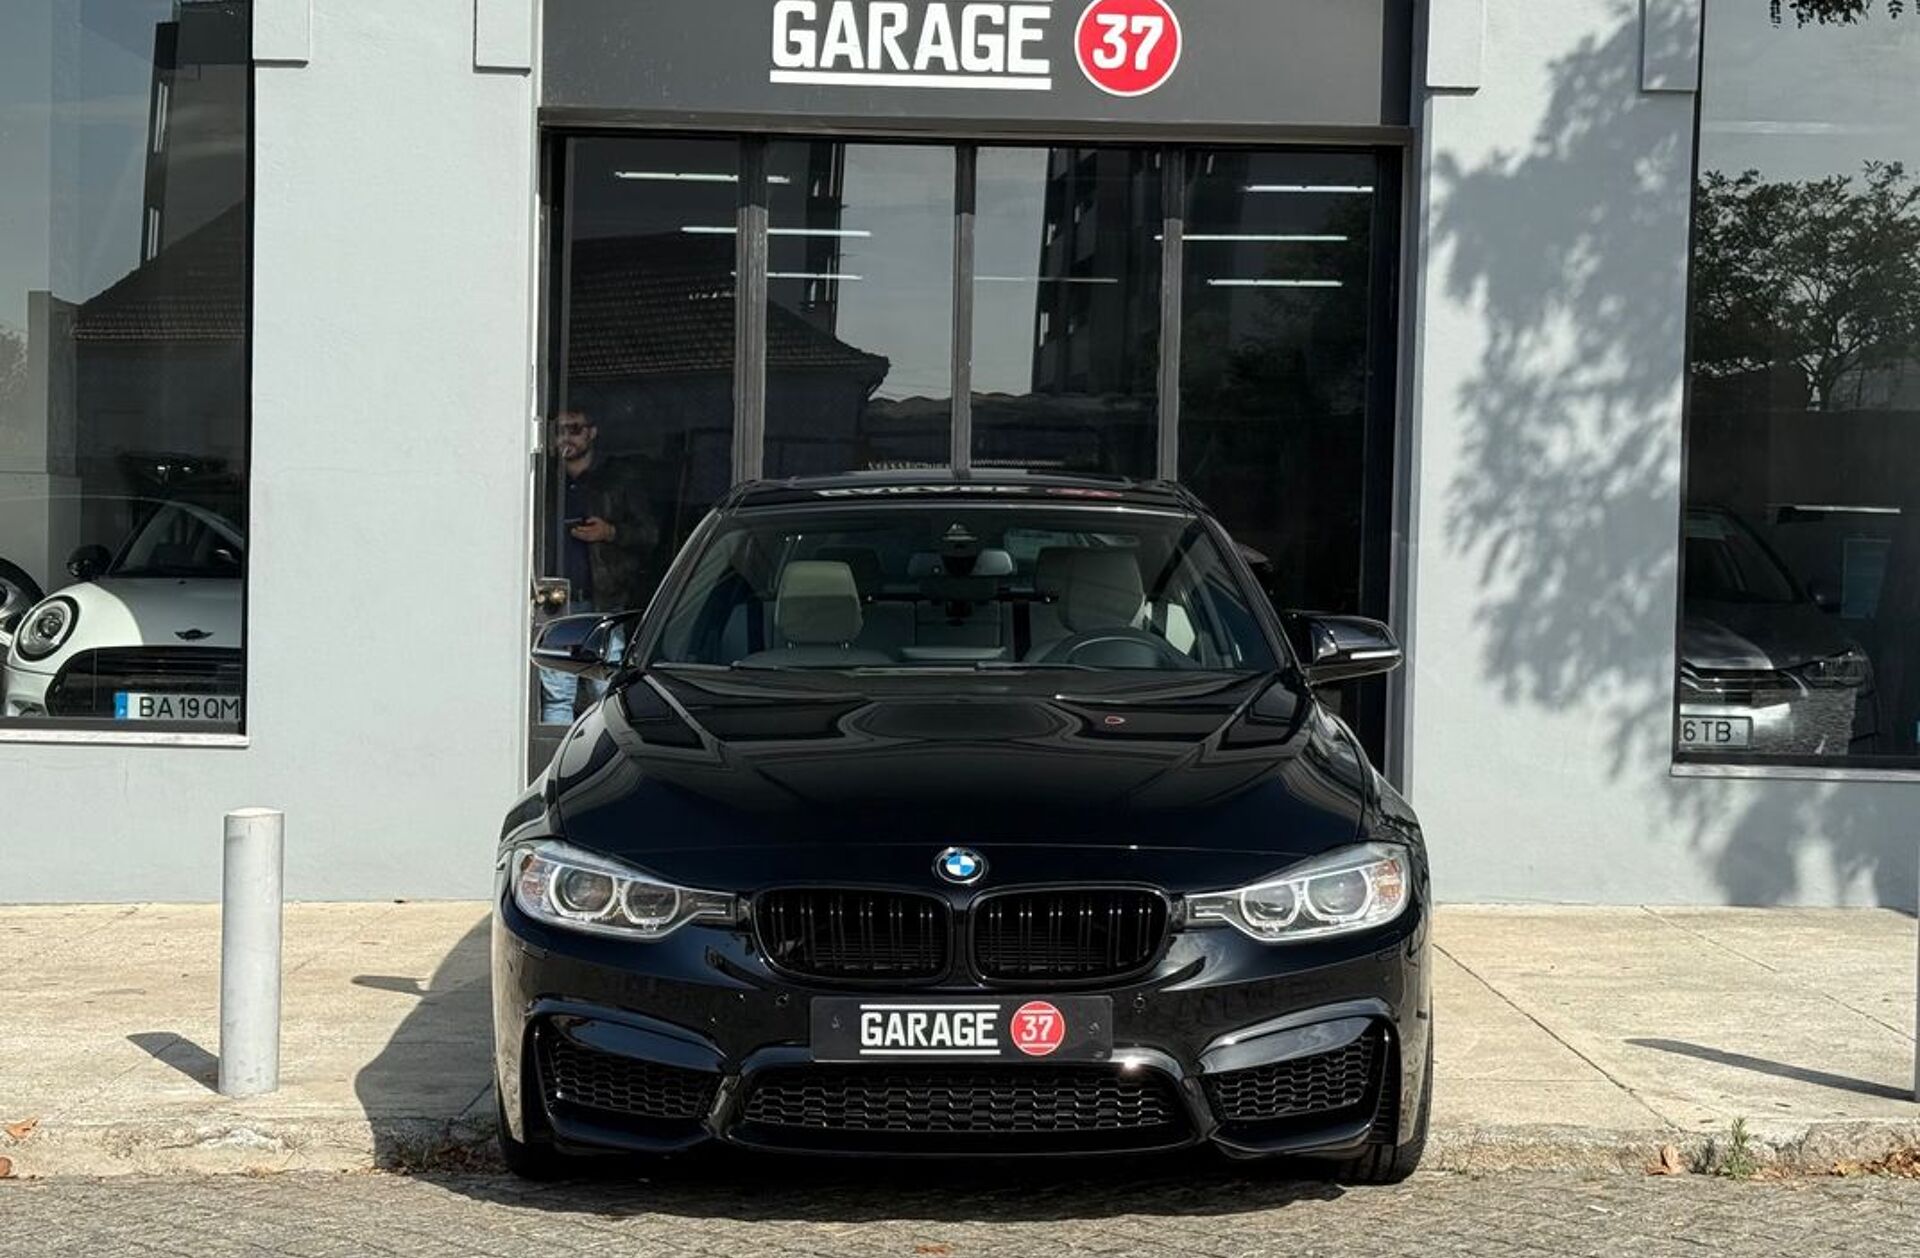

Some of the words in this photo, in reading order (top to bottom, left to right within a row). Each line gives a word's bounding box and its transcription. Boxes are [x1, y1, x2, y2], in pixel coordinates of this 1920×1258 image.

[772, 0, 1052, 73] GARAGE
[1092, 13, 1164, 71] 37
[140, 697, 173, 718] BA
[180, 698, 200, 719] 19
[203, 698, 239, 719] QM
[1701, 721, 1731, 742] TB
[860, 1012, 998, 1047] GARAGE
[1021, 1015, 1054, 1042] 37
